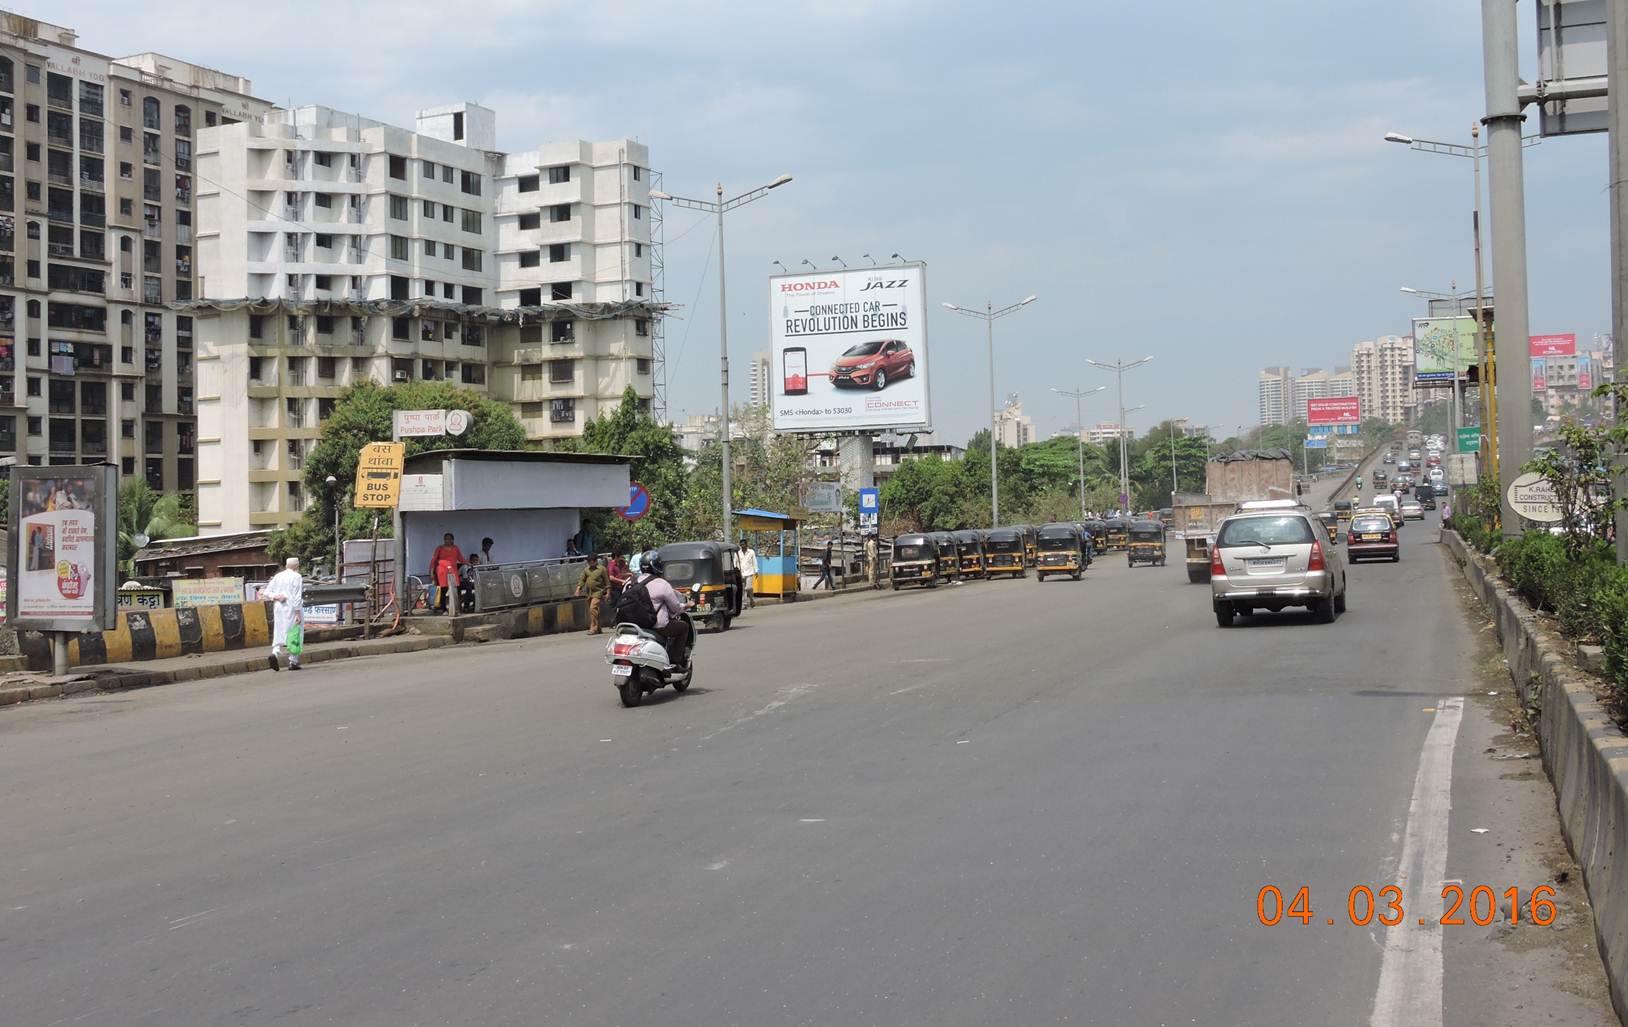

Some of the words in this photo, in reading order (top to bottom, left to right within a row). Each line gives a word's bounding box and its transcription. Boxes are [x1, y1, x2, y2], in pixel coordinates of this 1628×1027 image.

[781, 280, 840, 292] HONDA
[859, 279, 909, 292] JAZZ
[809, 302, 860, 317] CONNECTED
[863, 301, 881, 313] CAR
[786, 315, 858, 334] REVOLUTION
[863, 311, 907, 329] BEGINS
[867, 400, 919, 409] CONNECT
[780, 409, 793, 417] SMS
[428, 425, 442, 433] Park
[362, 493, 391, 501] STOP
[1522, 504, 1548, 513] SINCE
